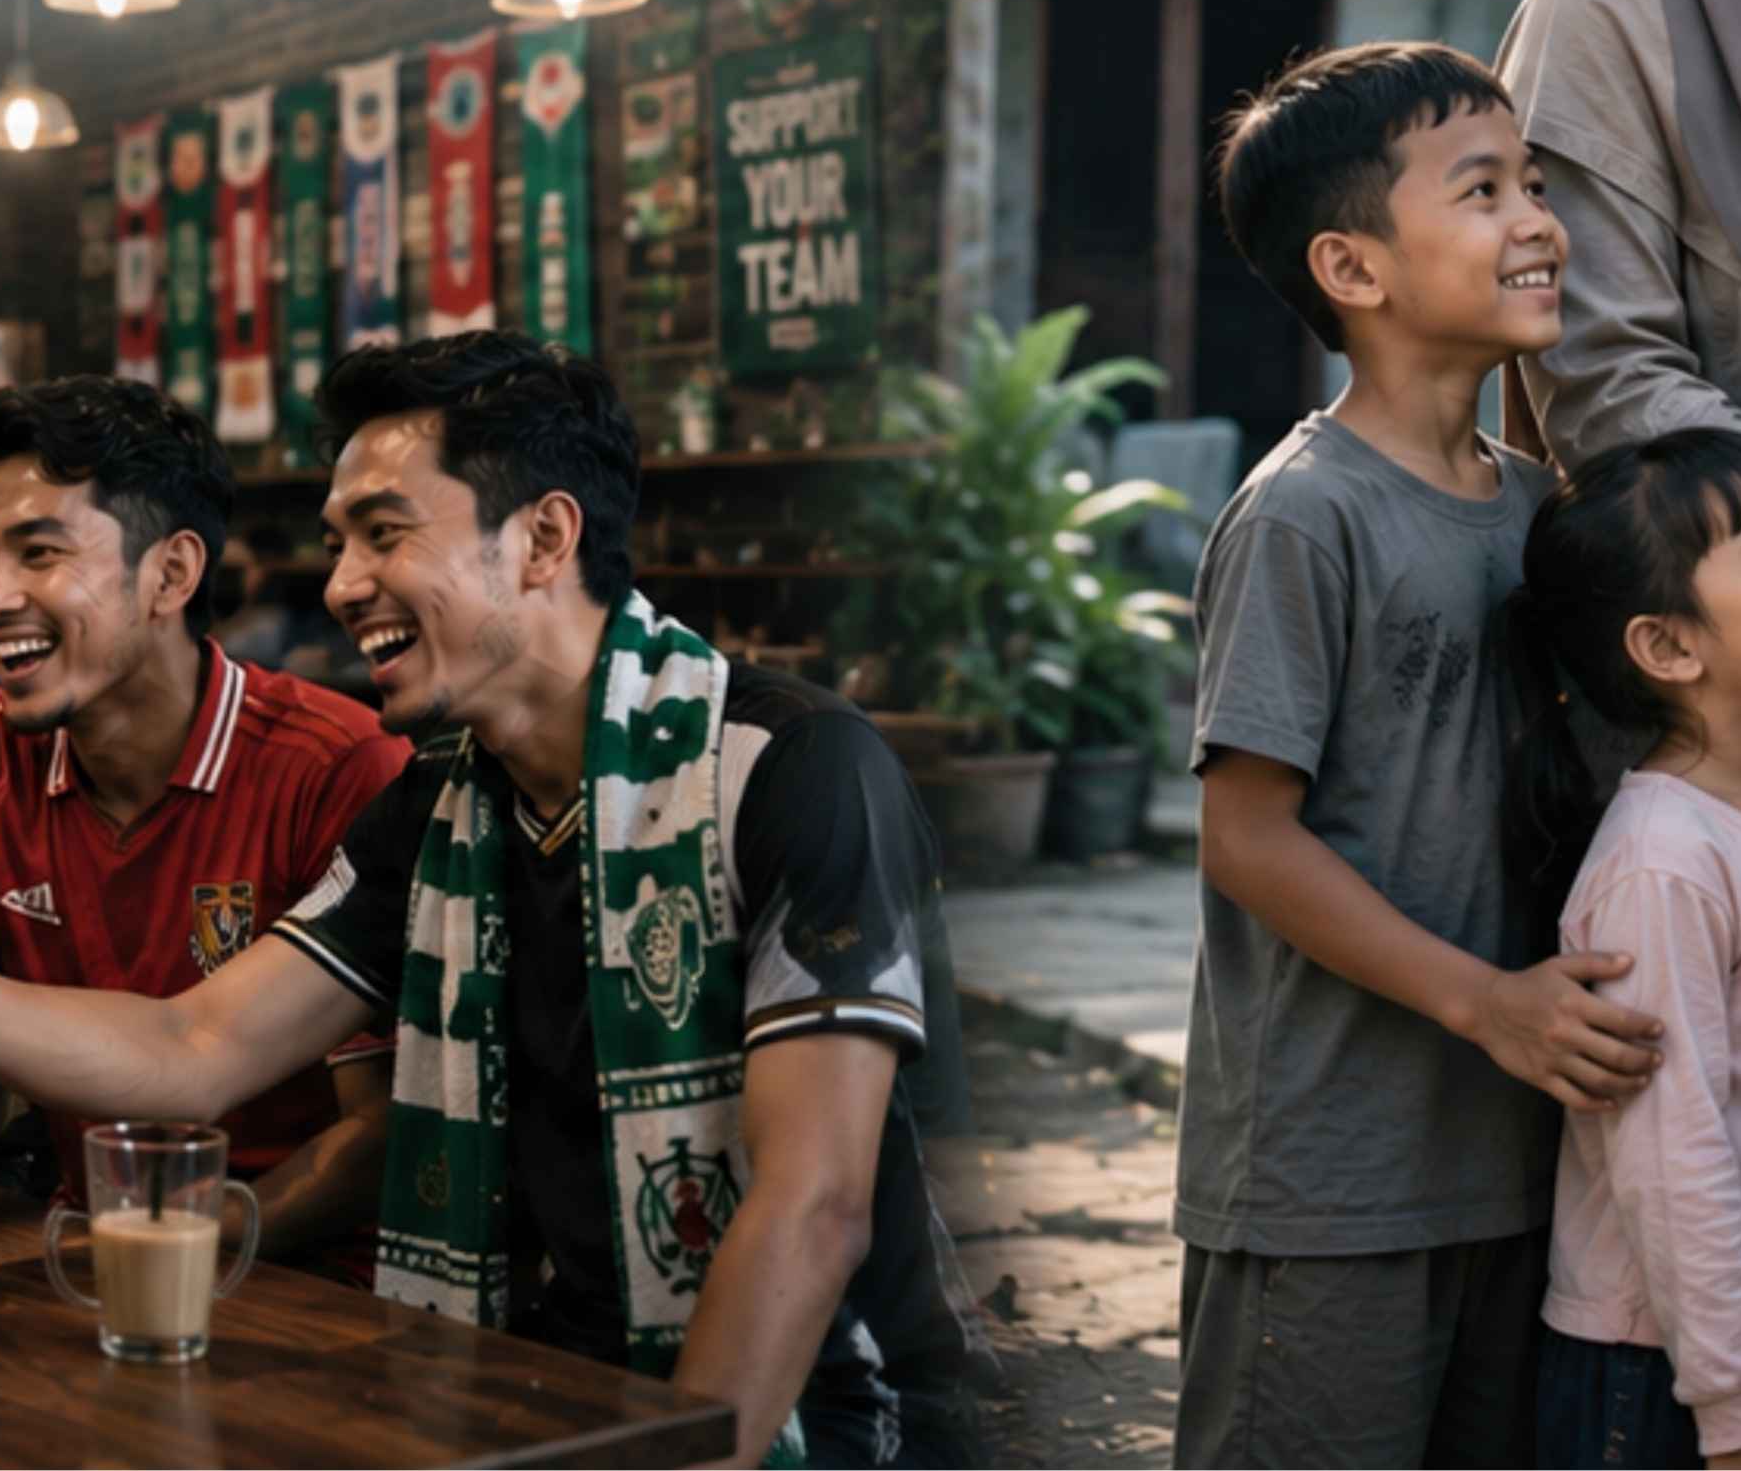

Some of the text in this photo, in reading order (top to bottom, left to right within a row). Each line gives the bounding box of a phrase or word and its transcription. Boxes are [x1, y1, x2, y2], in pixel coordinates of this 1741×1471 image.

[726, 78, 862, 158] SUPPORT
[742, 151, 847, 230] YOUR
[736, 232, 863, 315] TEAM
